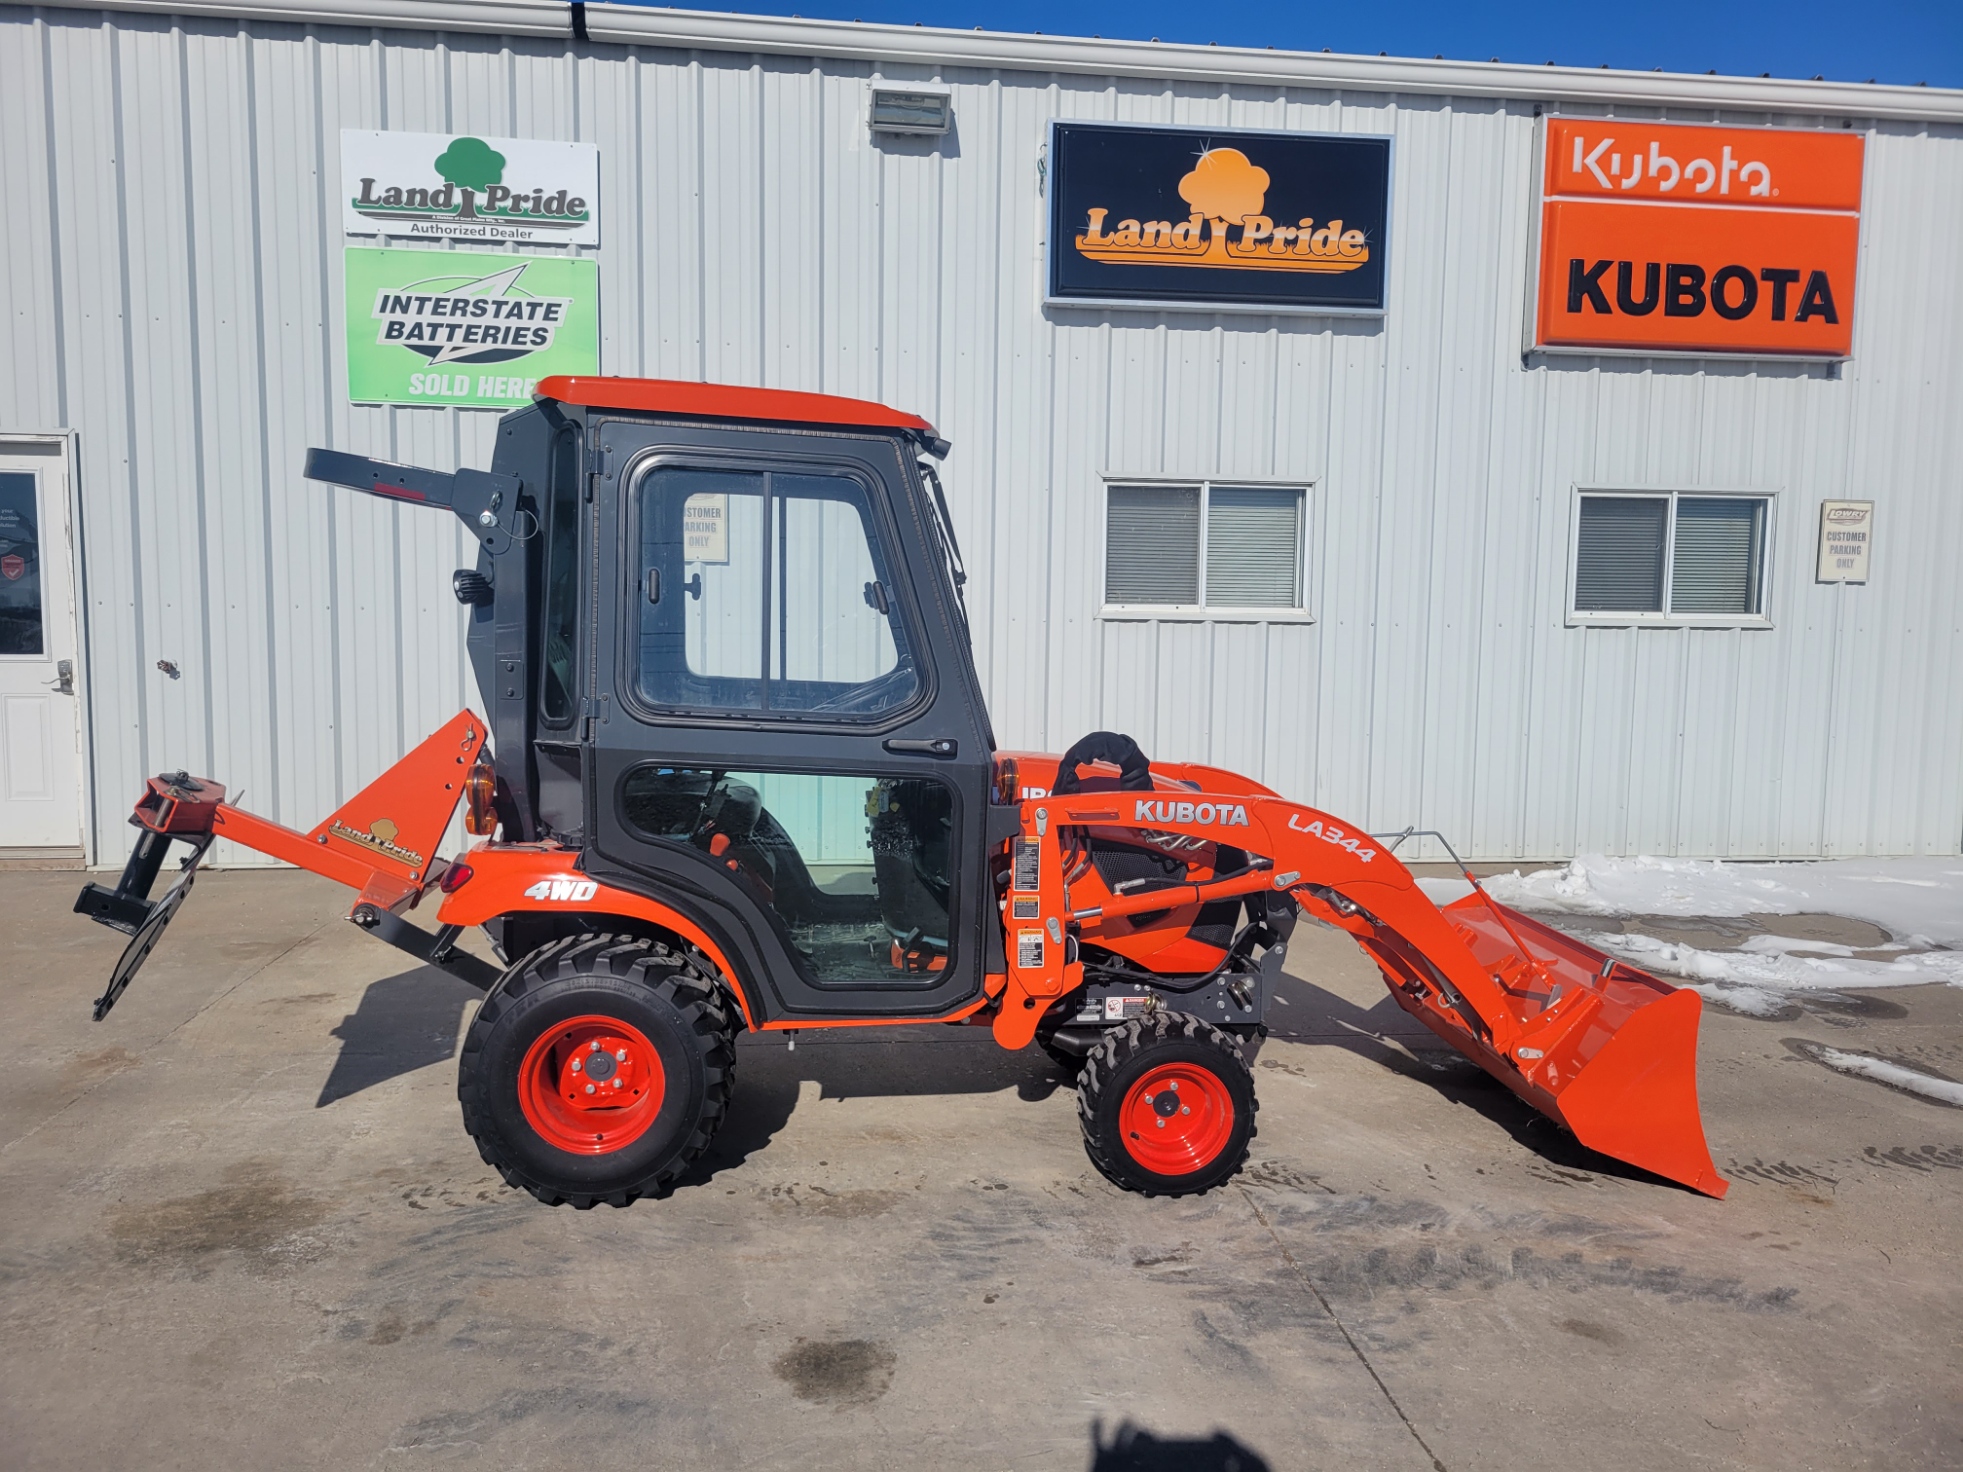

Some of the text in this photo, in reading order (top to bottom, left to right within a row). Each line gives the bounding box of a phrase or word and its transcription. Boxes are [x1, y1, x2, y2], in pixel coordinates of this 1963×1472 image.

[1572, 136, 1770, 197] Kubota
[357, 178, 586, 216] Land Pride
[410, 223, 533, 239] Authorized Dealer
[1083, 207, 1365, 257] Land Pride
[1566, 258, 1839, 325] KUBOTA
[379, 294, 562, 322] INTERSTATE
[385, 320, 549, 347] BATTERIES
[408, 373, 536, 399] SOLD HERE
[684, 507, 721, 518] STOMER
[684, 522, 716, 533] ARKING
[1826, 531, 1867, 542] CUSTOMER
[689, 536, 709, 547] ONLY
[1829, 545, 1862, 555] PARKING
[1836, 558, 1855, 568] ONLY
[1134, 800, 1249, 827] KUBOTA
[331, 819, 423, 864] Land Pride
[1287, 813, 1377, 863] LA344
[524, 880, 599, 901] 4WD
